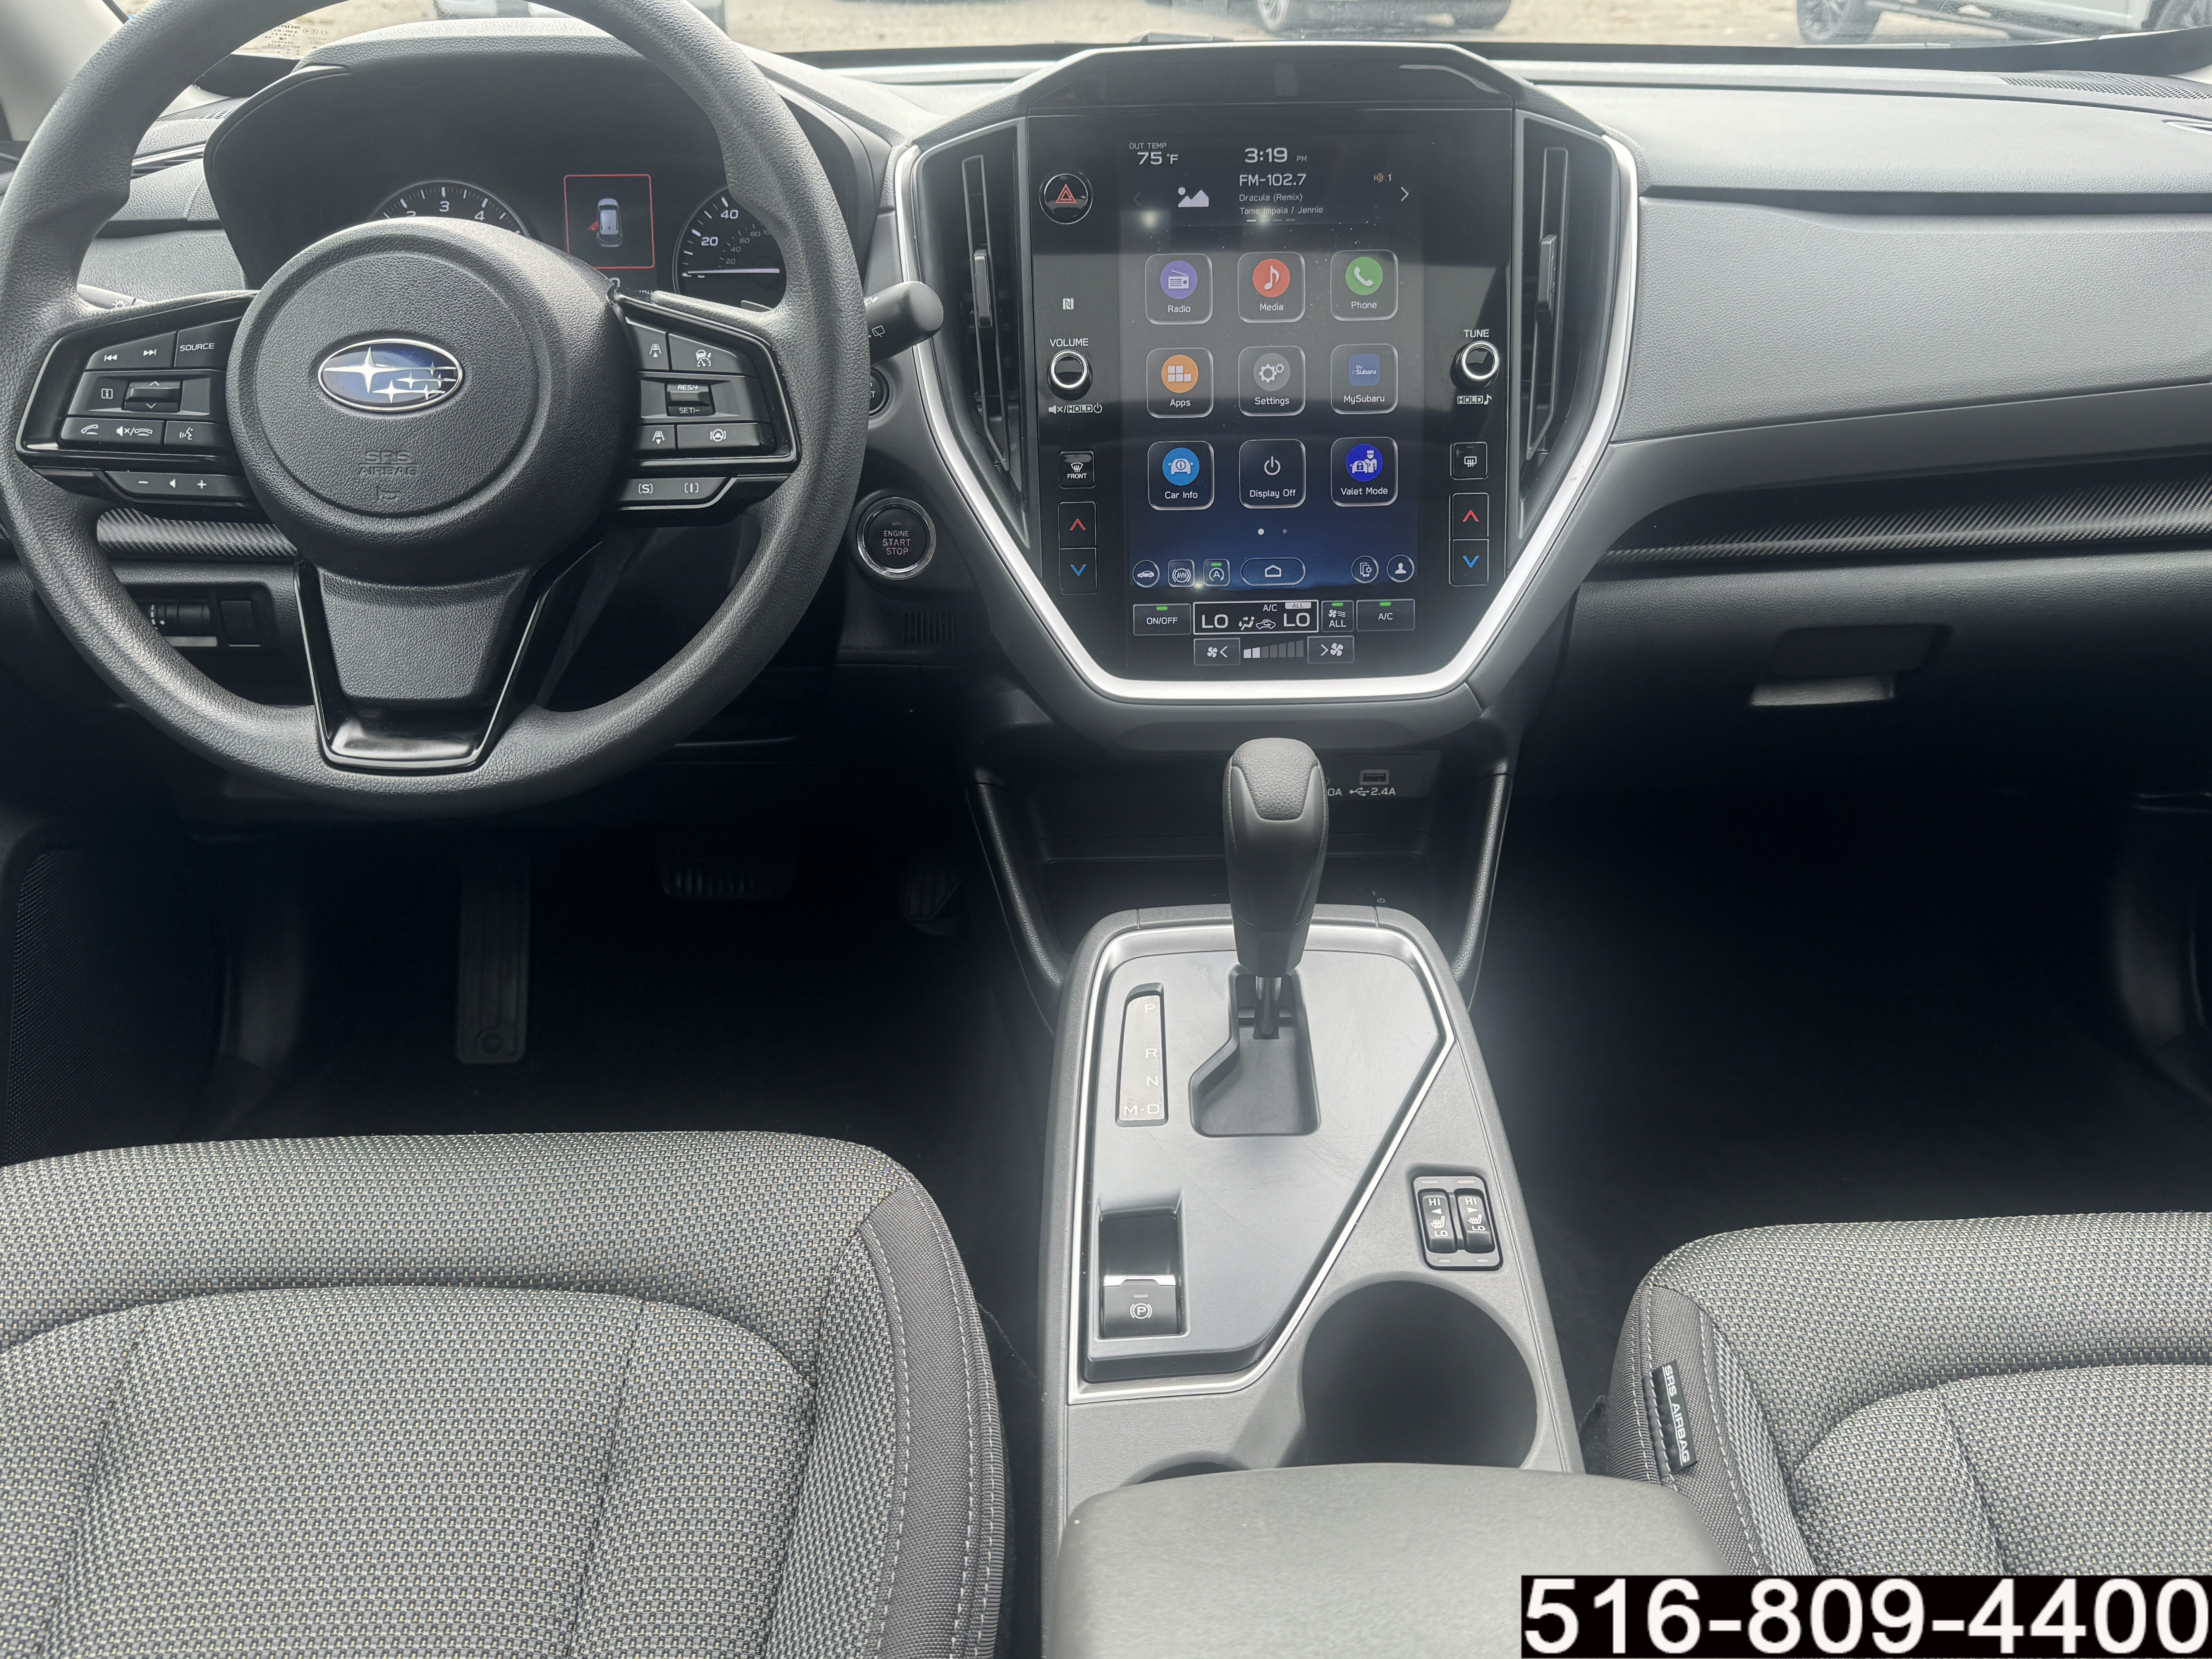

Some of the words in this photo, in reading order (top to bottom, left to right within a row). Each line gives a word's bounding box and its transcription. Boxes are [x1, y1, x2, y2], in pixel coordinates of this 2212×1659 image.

[1137, 151, 1162, 165] 75
[1245, 148, 1288, 163] 3:19
[1239, 173, 1306, 187] FM-102.7
[1388, 173, 1391, 182] 1
[1239, 194, 1270, 202] Dracula
[1273, 193, 1303, 203] (Remix)
[439, 201, 450, 212] 3
[1263, 206, 1288, 216] Impala
[1297, 206, 1323, 214] Jennie
[474, 210, 485, 221] 4
[720, 210, 738, 219] 40
[701, 237, 718, 246] 20
[1168, 305, 1191, 313] Radio
[1260, 303, 1284, 311] Media
[1463, 329, 1489, 338] TUNE
[1049, 338, 1089, 347] VOLUME
[179, 343, 215, 352] SOURCE
[1170, 398, 1191, 408] Apps
[1254, 397, 1290, 406] Settings
[1344, 395, 1385, 405] MySubaru
[365, 451, 411, 464] SRS
[359, 467, 418, 475] AIRBAG
[1165, 491, 1179, 499] Car
[1250, 489, 1279, 499] Display
[1283, 489, 1296, 497] Off
[1366, 487, 1388, 495] Mode
[883, 538, 911, 546] START
[886, 547, 908, 555] STOP
[1202, 614, 1228, 629] LO
[1283, 612, 1310, 627] LO
[1329, 620, 1347, 628] ALL
[1371, 787, 1396, 795] 2.4A
[1146, 1048, 1158, 1058] R
[1146, 1075, 1159, 1087] N
[1429, 1198, 1441, 1206] HI
[1465, 1197, 1477, 1205] HI
[1434, 1230, 1448, 1238] LO
[1665, 1365, 1677, 1397] SRS
[1672, 1403, 1690, 1463] AIRBAG
